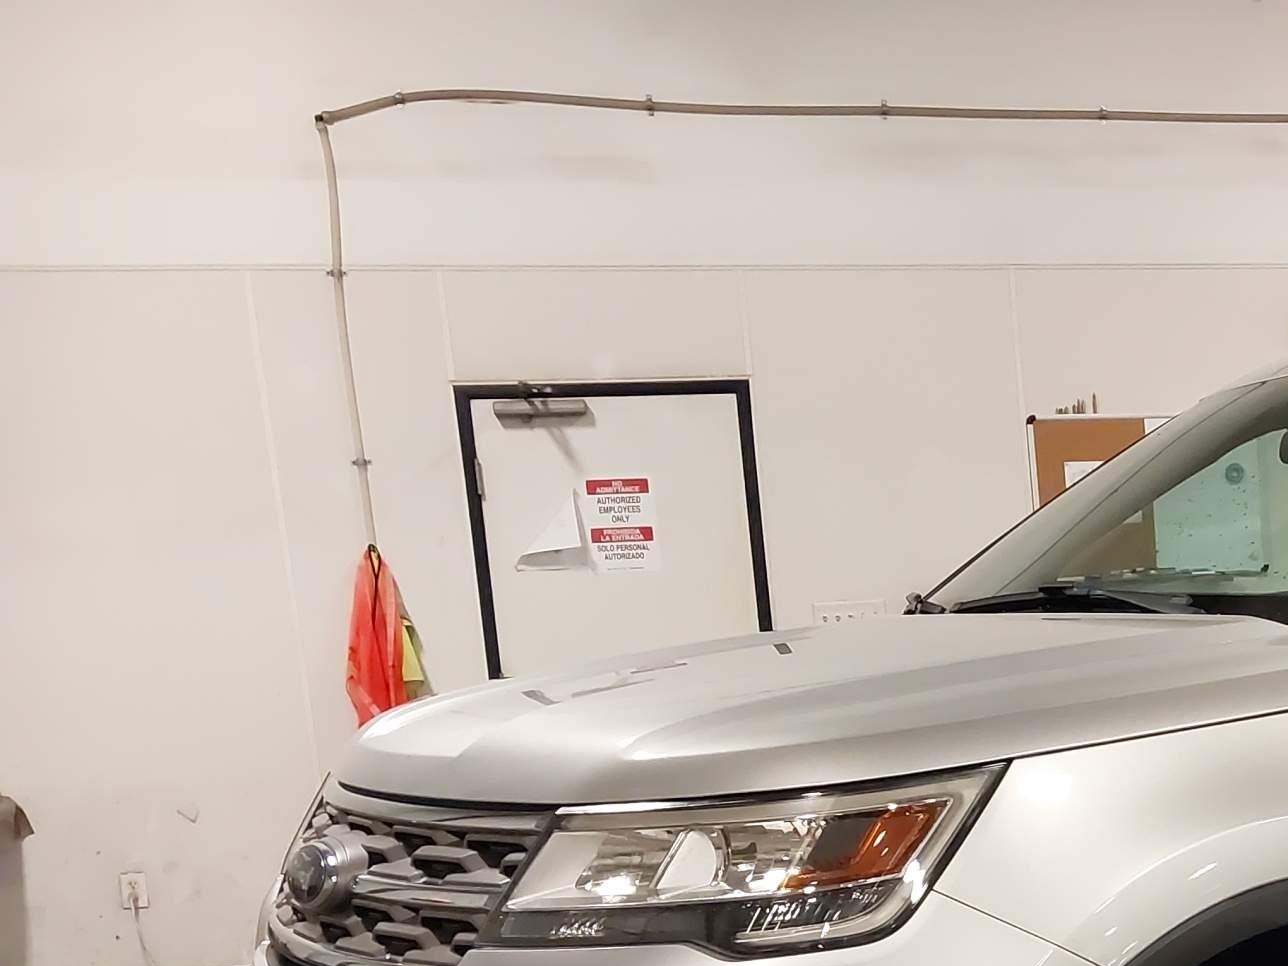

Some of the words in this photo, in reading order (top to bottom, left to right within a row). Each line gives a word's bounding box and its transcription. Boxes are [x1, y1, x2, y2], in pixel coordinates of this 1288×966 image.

[597, 496, 641, 505] AUTHORIZED
[598, 505, 641, 514] EMPLOYEES
[611, 515, 630, 523] ONLY
[597, 545, 615, 553] SOLO
[616, 543, 650, 552] PERSONAL
[604, 552, 645, 561] AUTORIZADO
